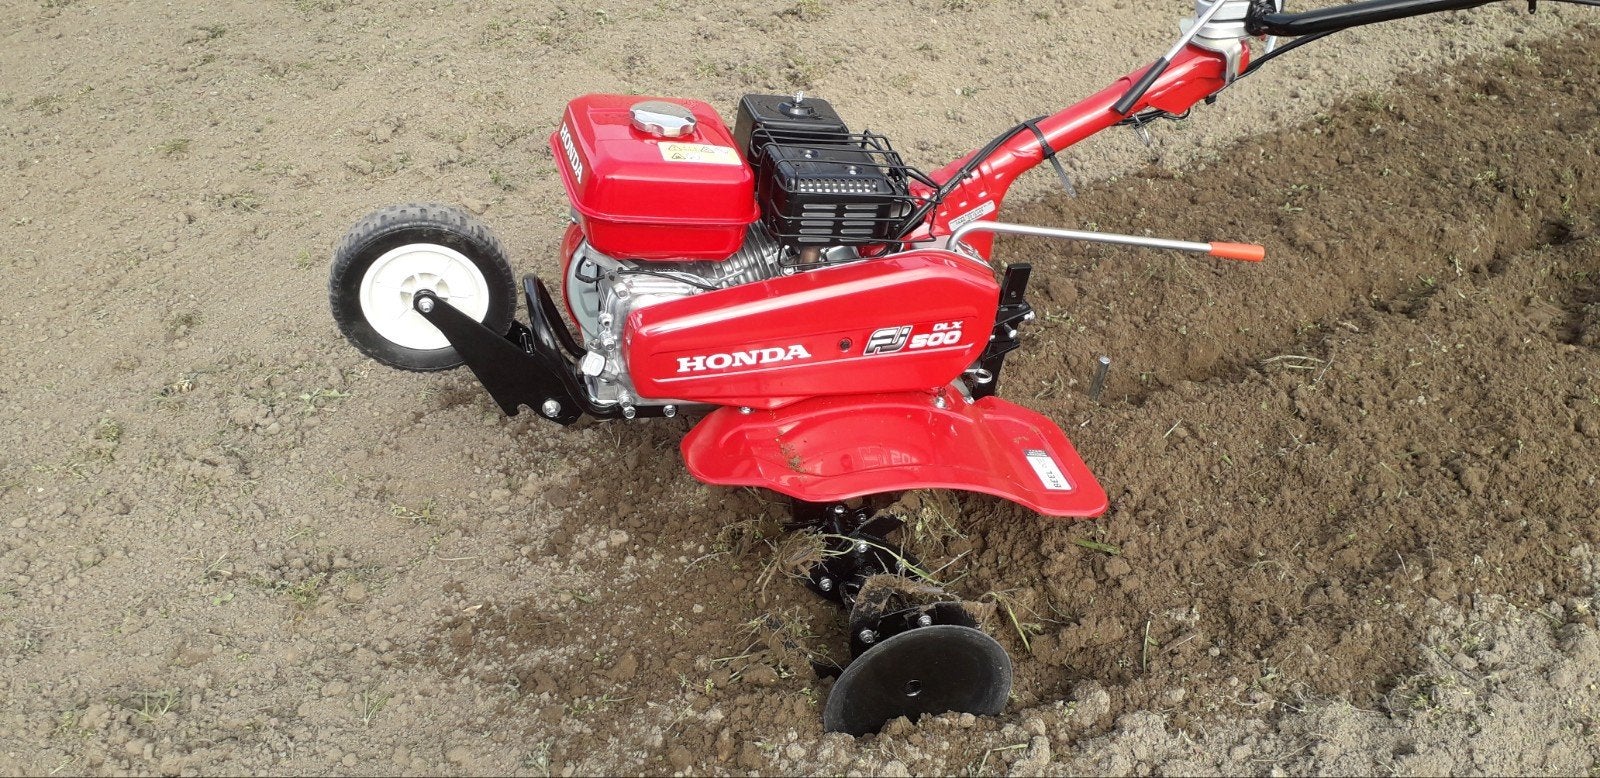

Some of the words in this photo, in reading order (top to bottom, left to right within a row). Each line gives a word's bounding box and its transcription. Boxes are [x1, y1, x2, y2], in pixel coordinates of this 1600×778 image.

[560, 121, 583, 184] HONDA
[933, 320, 963, 331] DLX
[909, 330, 963, 349] 500
[676, 344, 812, 373] HONDA
